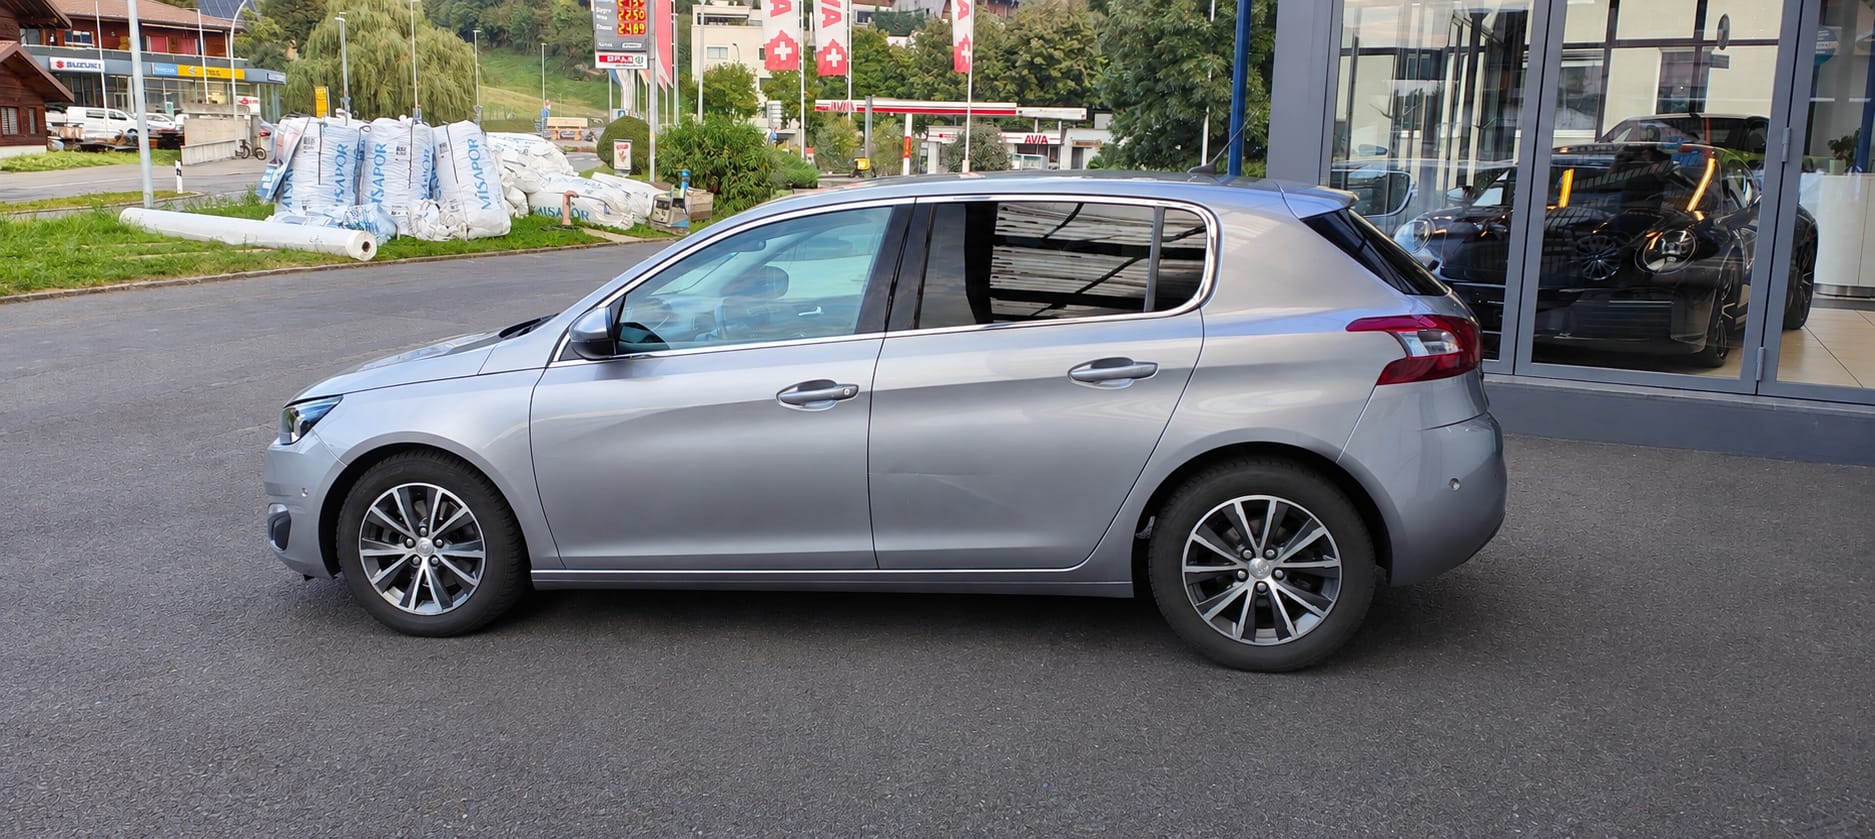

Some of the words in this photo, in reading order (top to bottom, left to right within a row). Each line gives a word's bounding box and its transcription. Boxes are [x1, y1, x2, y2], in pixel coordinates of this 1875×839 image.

[66, 61, 101, 69] SUZUKI
[1025, 134, 1049, 144] AVIA
[370, 143, 388, 203] ISAPOR
[466, 138, 492, 210] MISAPOR
[535, 205, 590, 221] MISAOR
